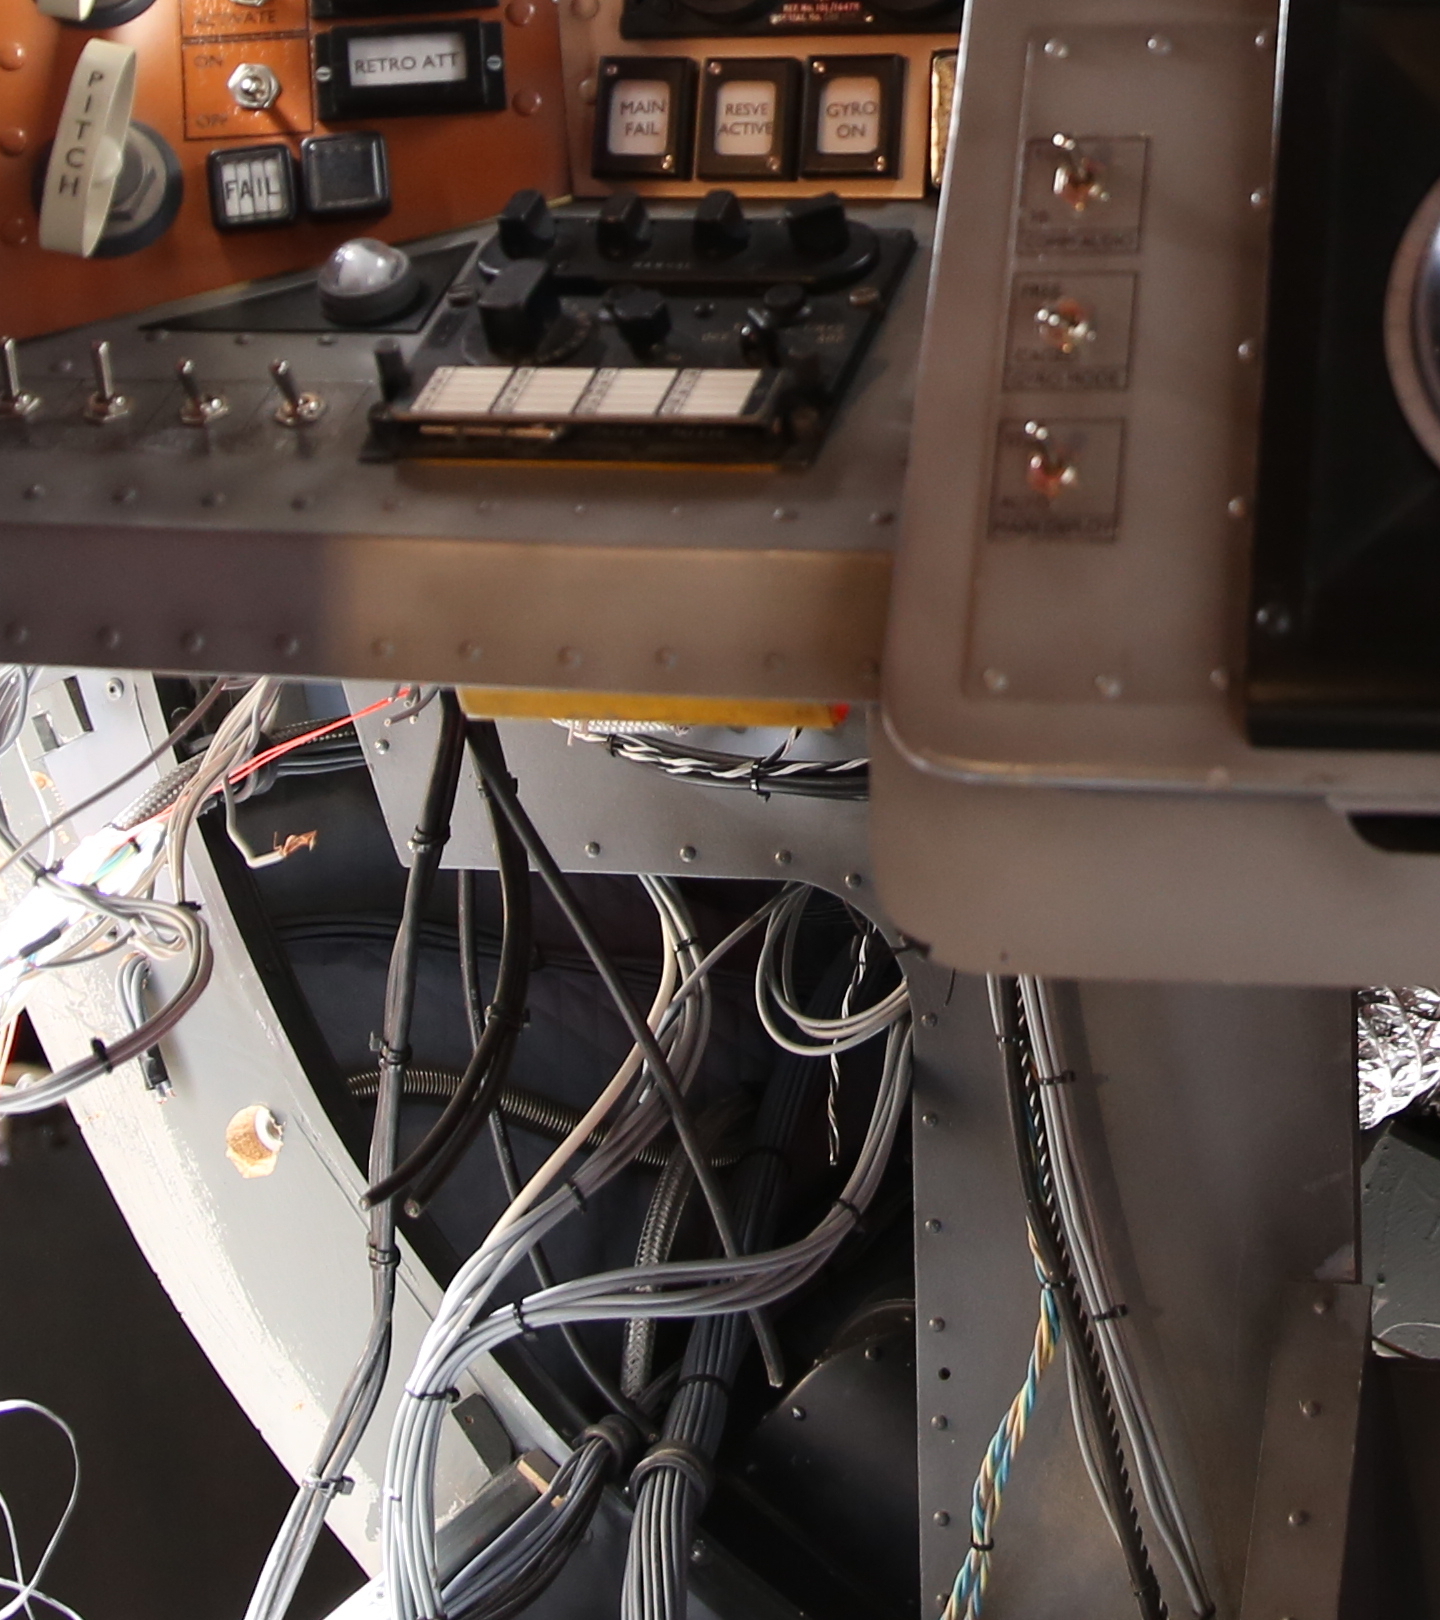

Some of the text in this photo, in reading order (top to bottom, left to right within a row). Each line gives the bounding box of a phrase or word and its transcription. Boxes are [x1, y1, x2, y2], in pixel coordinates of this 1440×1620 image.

[192, 9, 277, 28] ACTIVATE
[193, 54, 224, 69] ON
[354, 52, 460, 73] RETRO ATT
[620, 101, 666, 115] MAIN
[725, 103, 770, 116] RESVE
[826, 102, 878, 117] GYRO
[58, 70, 103, 198] PITCH
[625, 122, 660, 136] FAIL
[717, 122, 774, 136] ACTIVE
[836, 123, 867, 139] ON
[223, 176, 280, 203] FAIL
